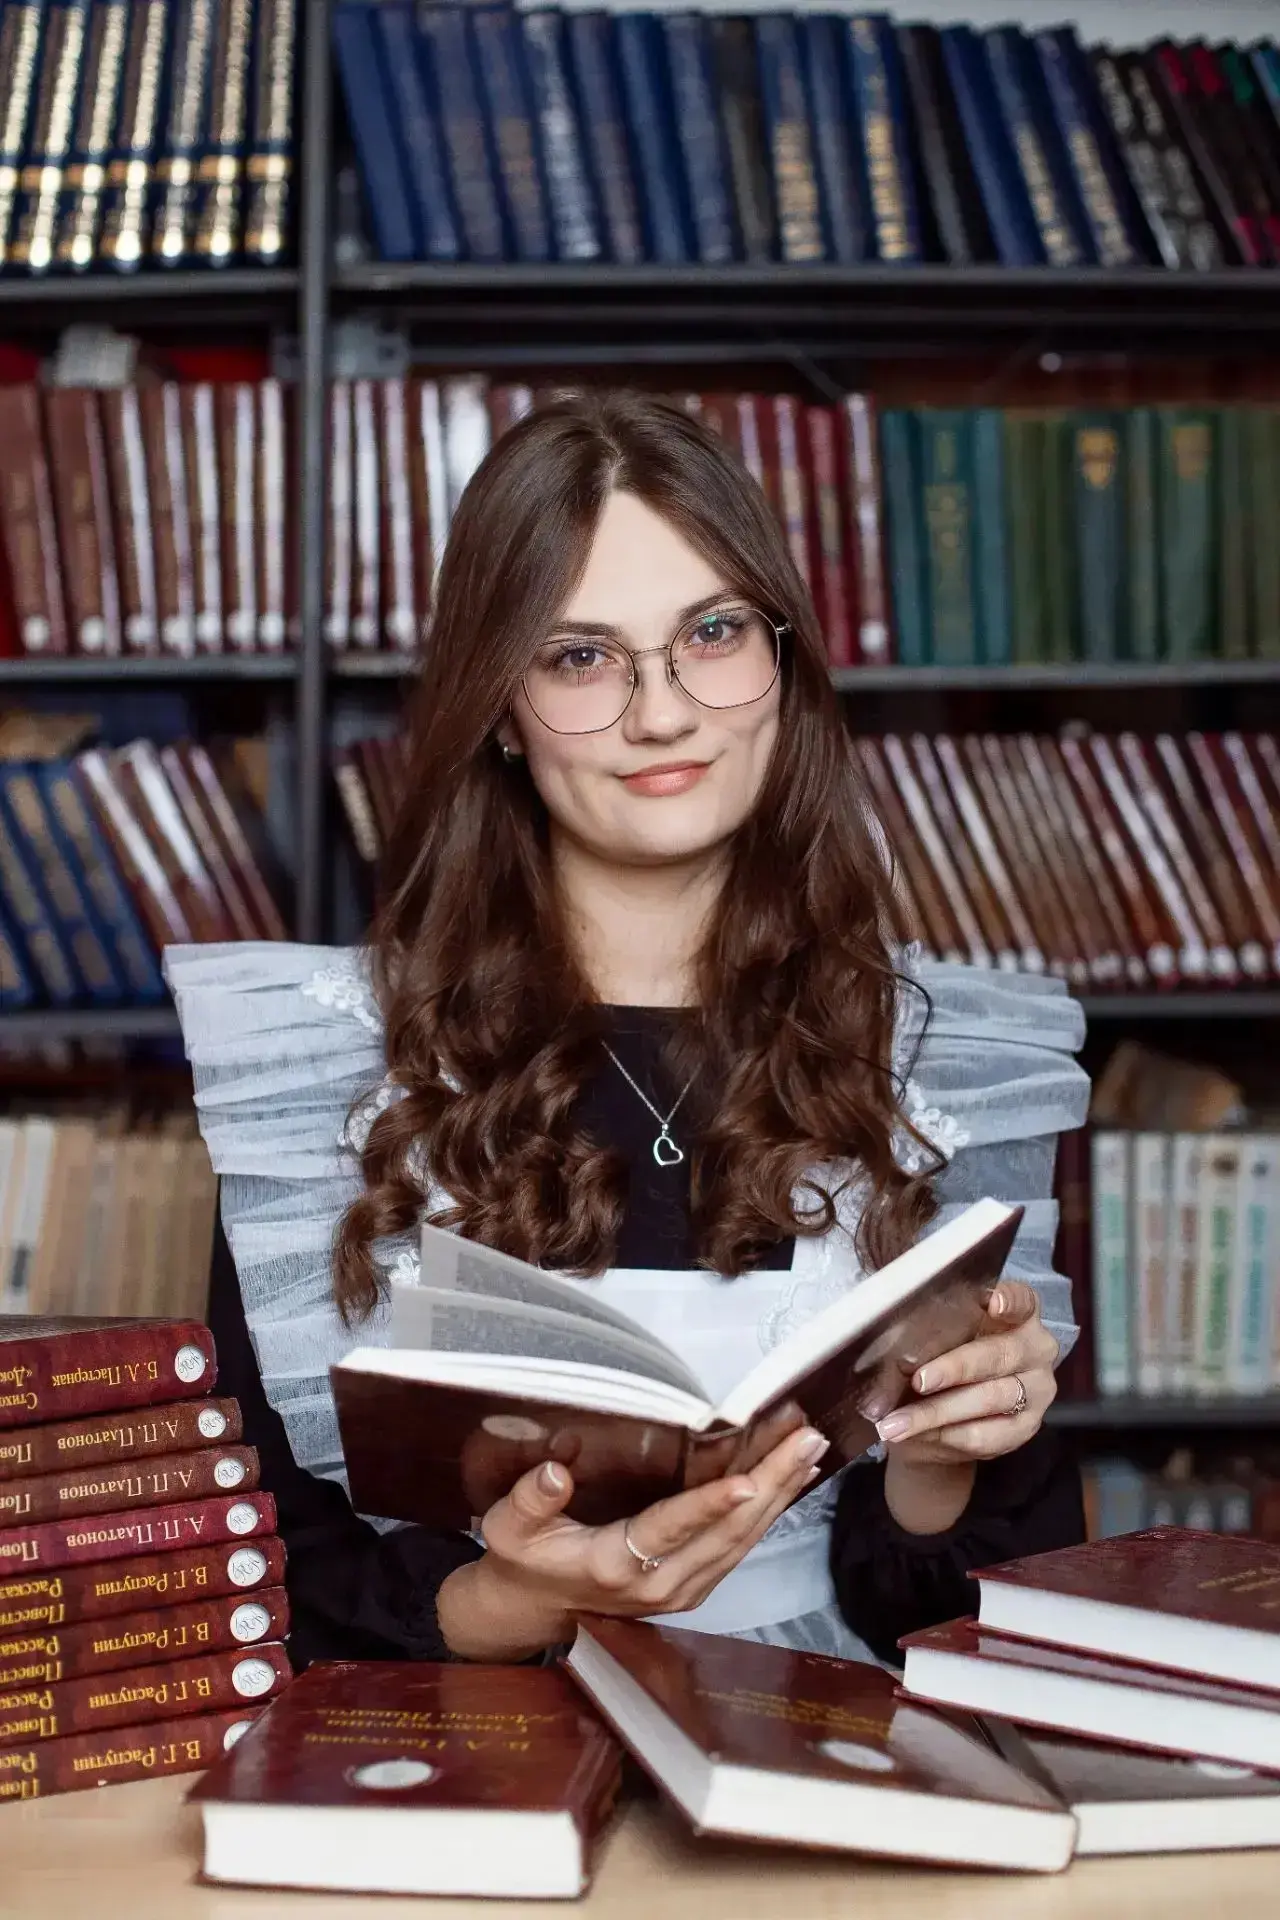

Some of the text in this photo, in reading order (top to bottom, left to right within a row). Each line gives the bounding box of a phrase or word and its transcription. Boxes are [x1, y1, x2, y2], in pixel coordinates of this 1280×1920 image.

[52, 1361, 158, 1387] Б. Л. Пастернак
[58, 1419, 179, 1450] А. П. Платонов
[59, 1469, 193, 1500] А. П. Платонов
[66, 1515, 206, 1548] А. П. Платонов
[95, 1566, 208, 1597] В. Г. Распутин
[94, 1622, 209, 1654] В. Г. Распутин
[89, 1677, 211, 1709] В. Г. Распутин
[73, 1740, 201, 1771] В. Г. Распутин
